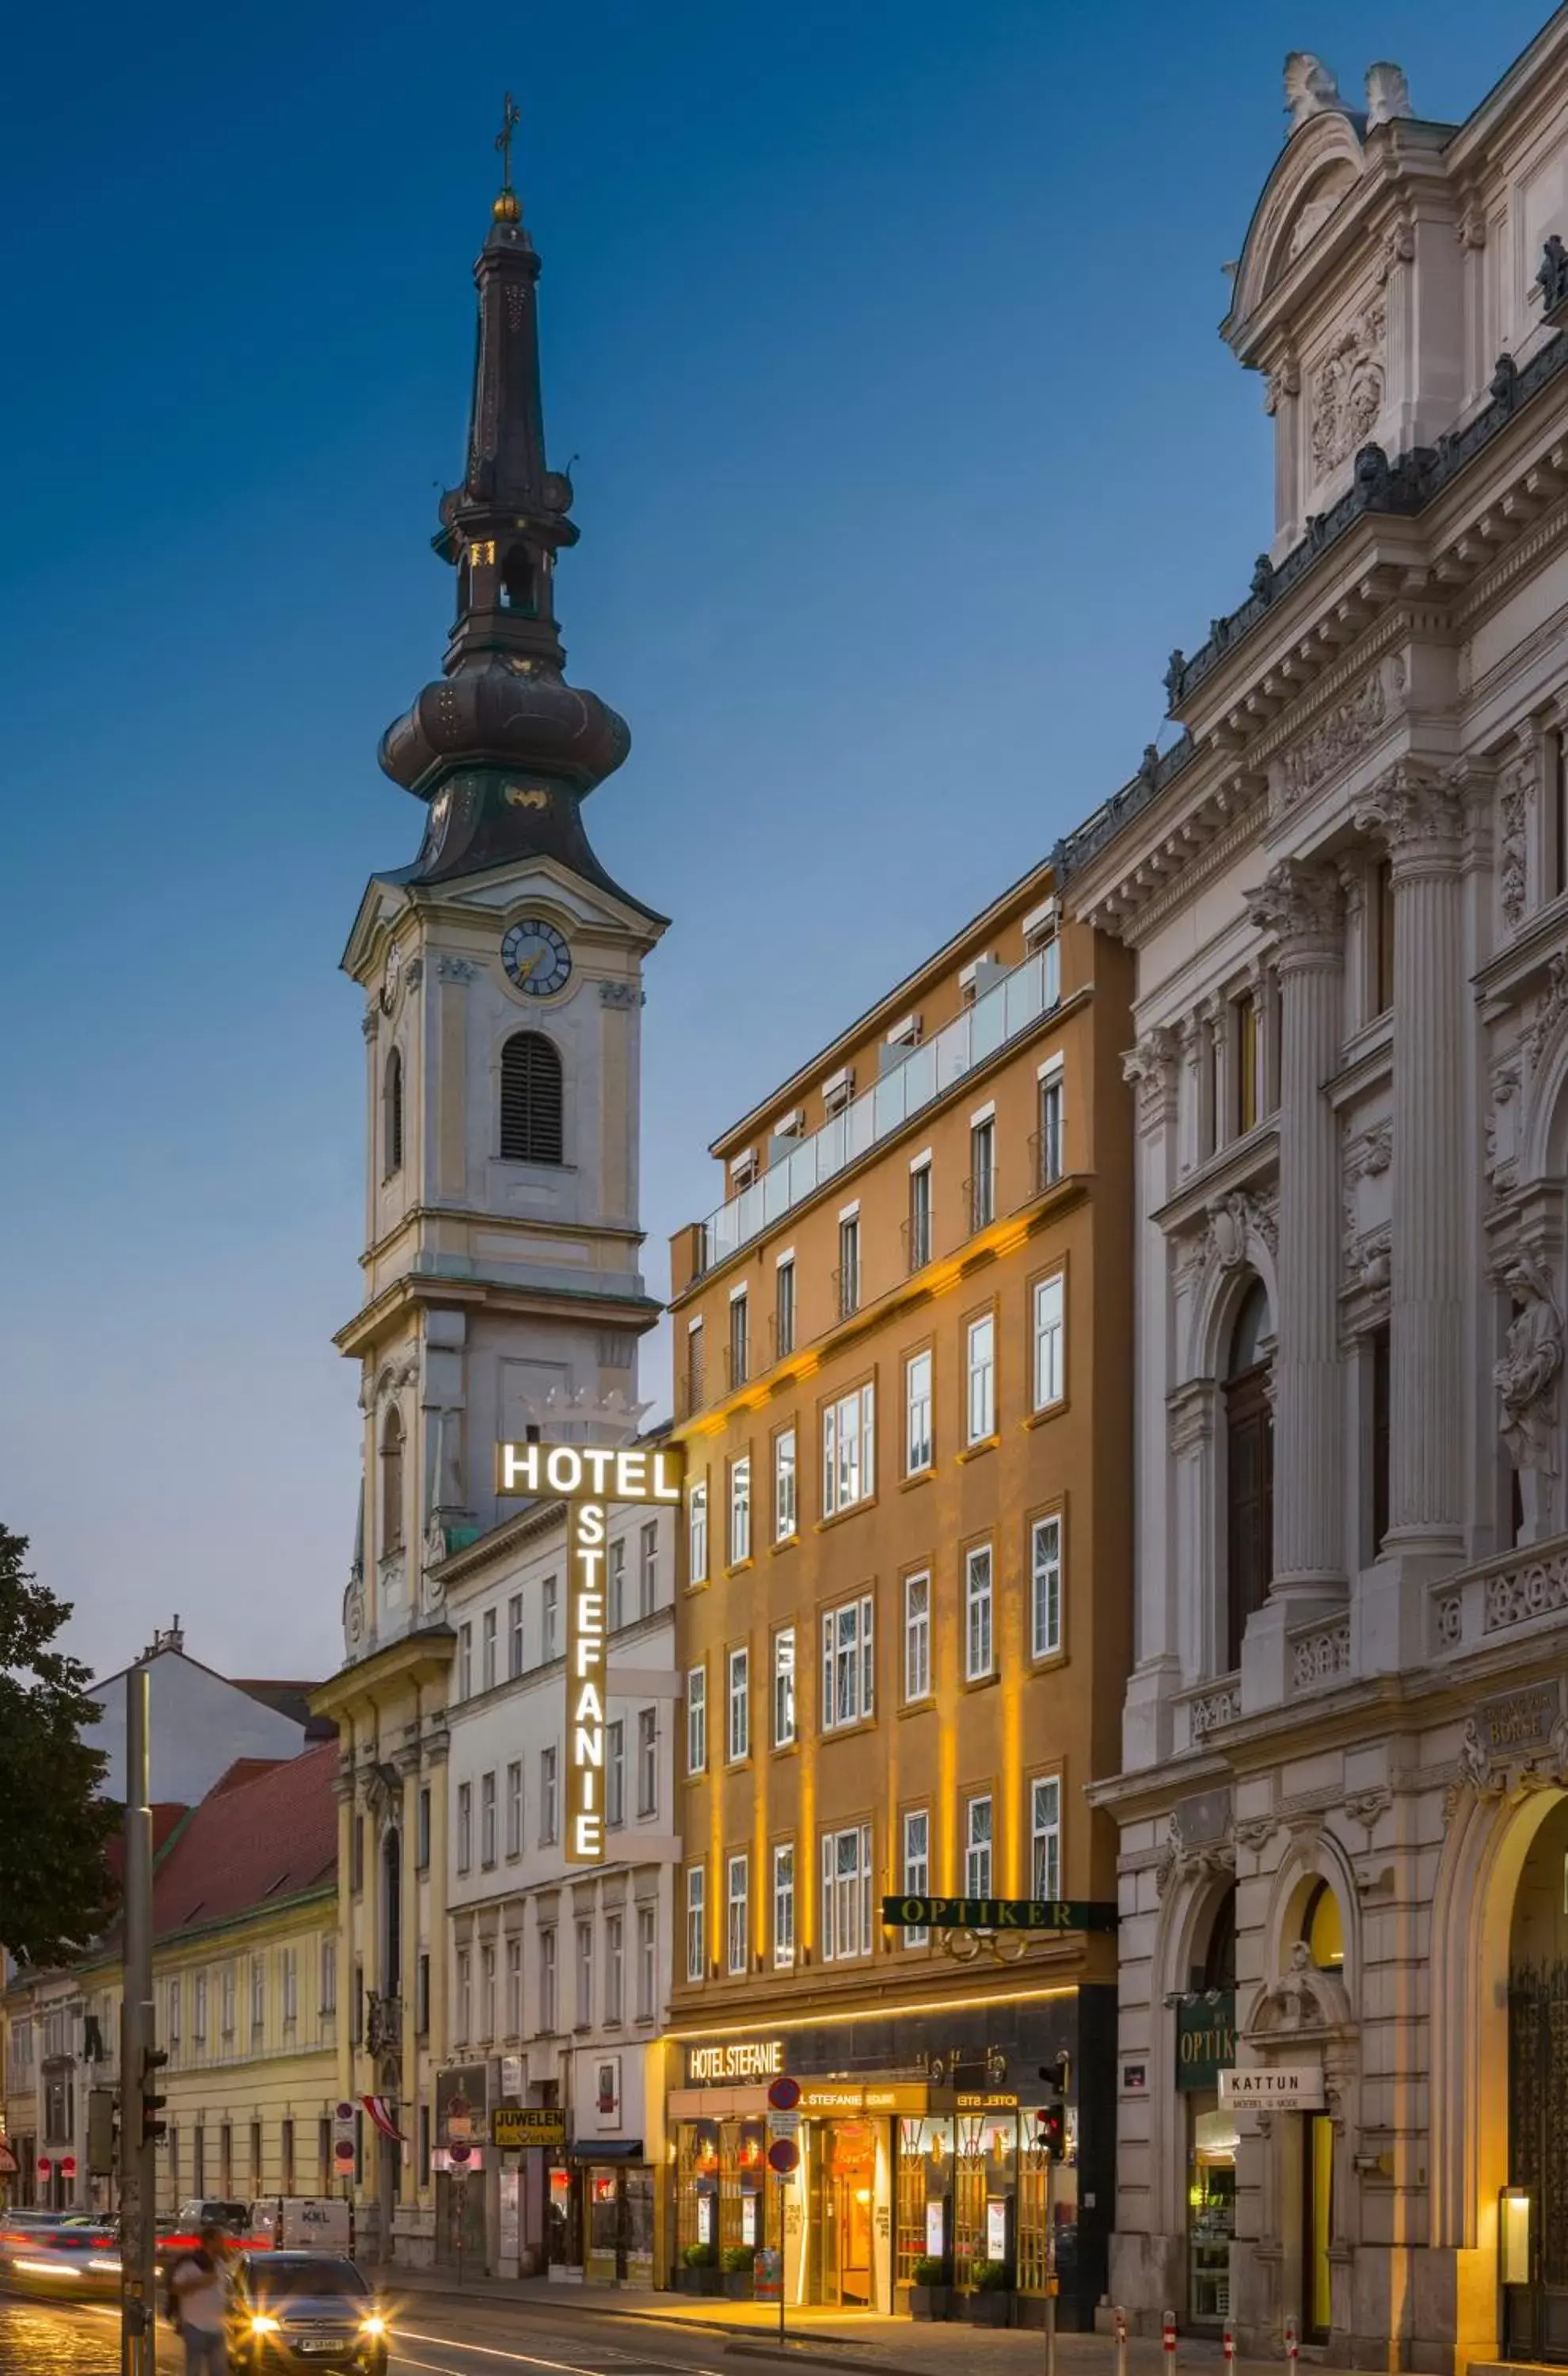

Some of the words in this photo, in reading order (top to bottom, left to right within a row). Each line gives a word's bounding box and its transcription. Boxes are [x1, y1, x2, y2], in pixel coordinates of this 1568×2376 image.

[503, 1445, 679, 1498] HOTEL
[575, 1504, 603, 1856] STEFANIE
[901, 1898, 1071, 1926] OPTIKER
[691, 2047, 726, 2079] HOTEL
[726, 2041, 782, 2076] STEFANIE
[1181, 2028, 1235, 2063] OPTIK
[1231, 2075, 1299, 2091] KATTUN
[809, 2093, 862, 2105] STEFANIE
[497, 2111, 563, 2127] JUWELEN
